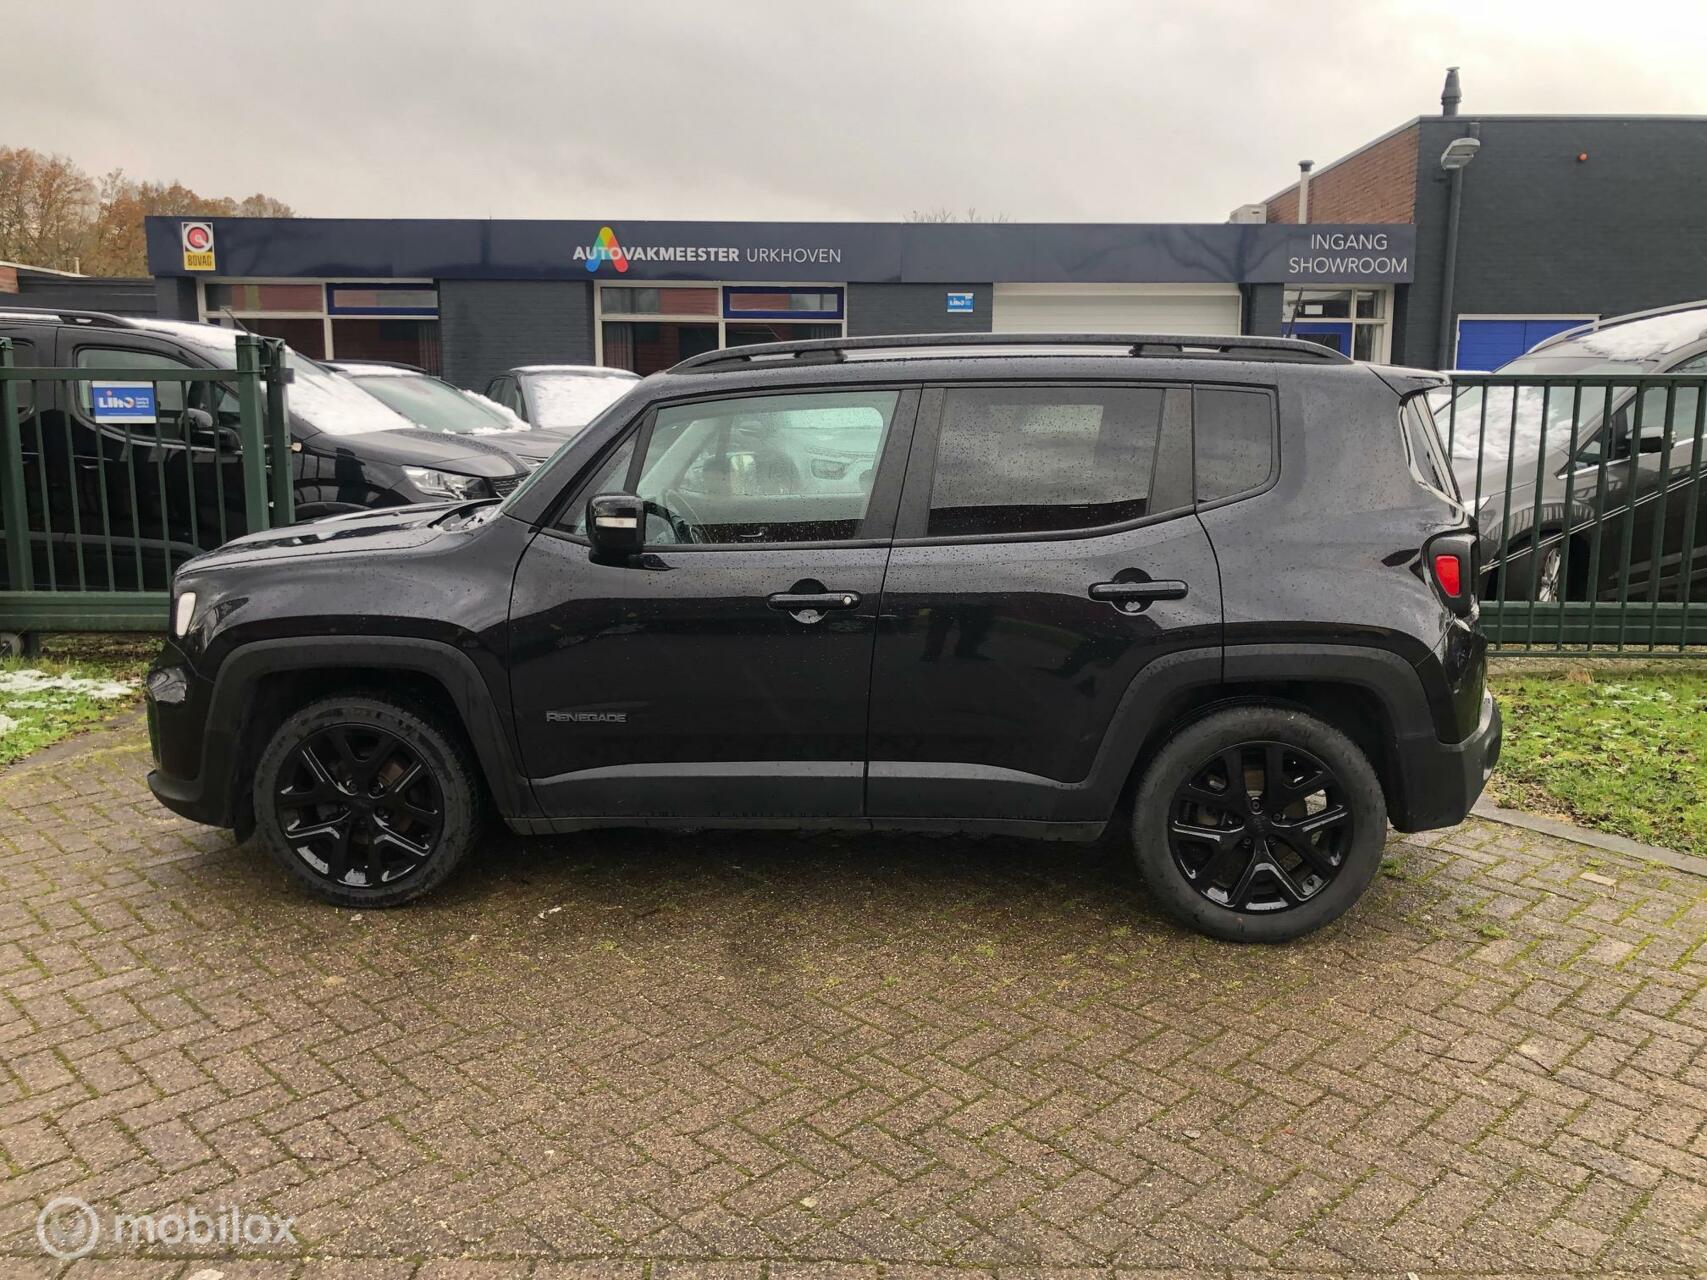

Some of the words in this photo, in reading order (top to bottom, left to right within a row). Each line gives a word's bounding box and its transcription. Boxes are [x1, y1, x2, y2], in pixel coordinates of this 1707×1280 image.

[1311, 234, 1388, 250] INGANG
[187, 254, 212, 266] BOVAG
[573, 246, 740, 262] AUTOVAKMEESTER
[746, 248, 841, 263] URKHOVEN
[1288, 257, 1408, 273] SHOWROOM
[546, 711, 627, 722] RENEGADE
